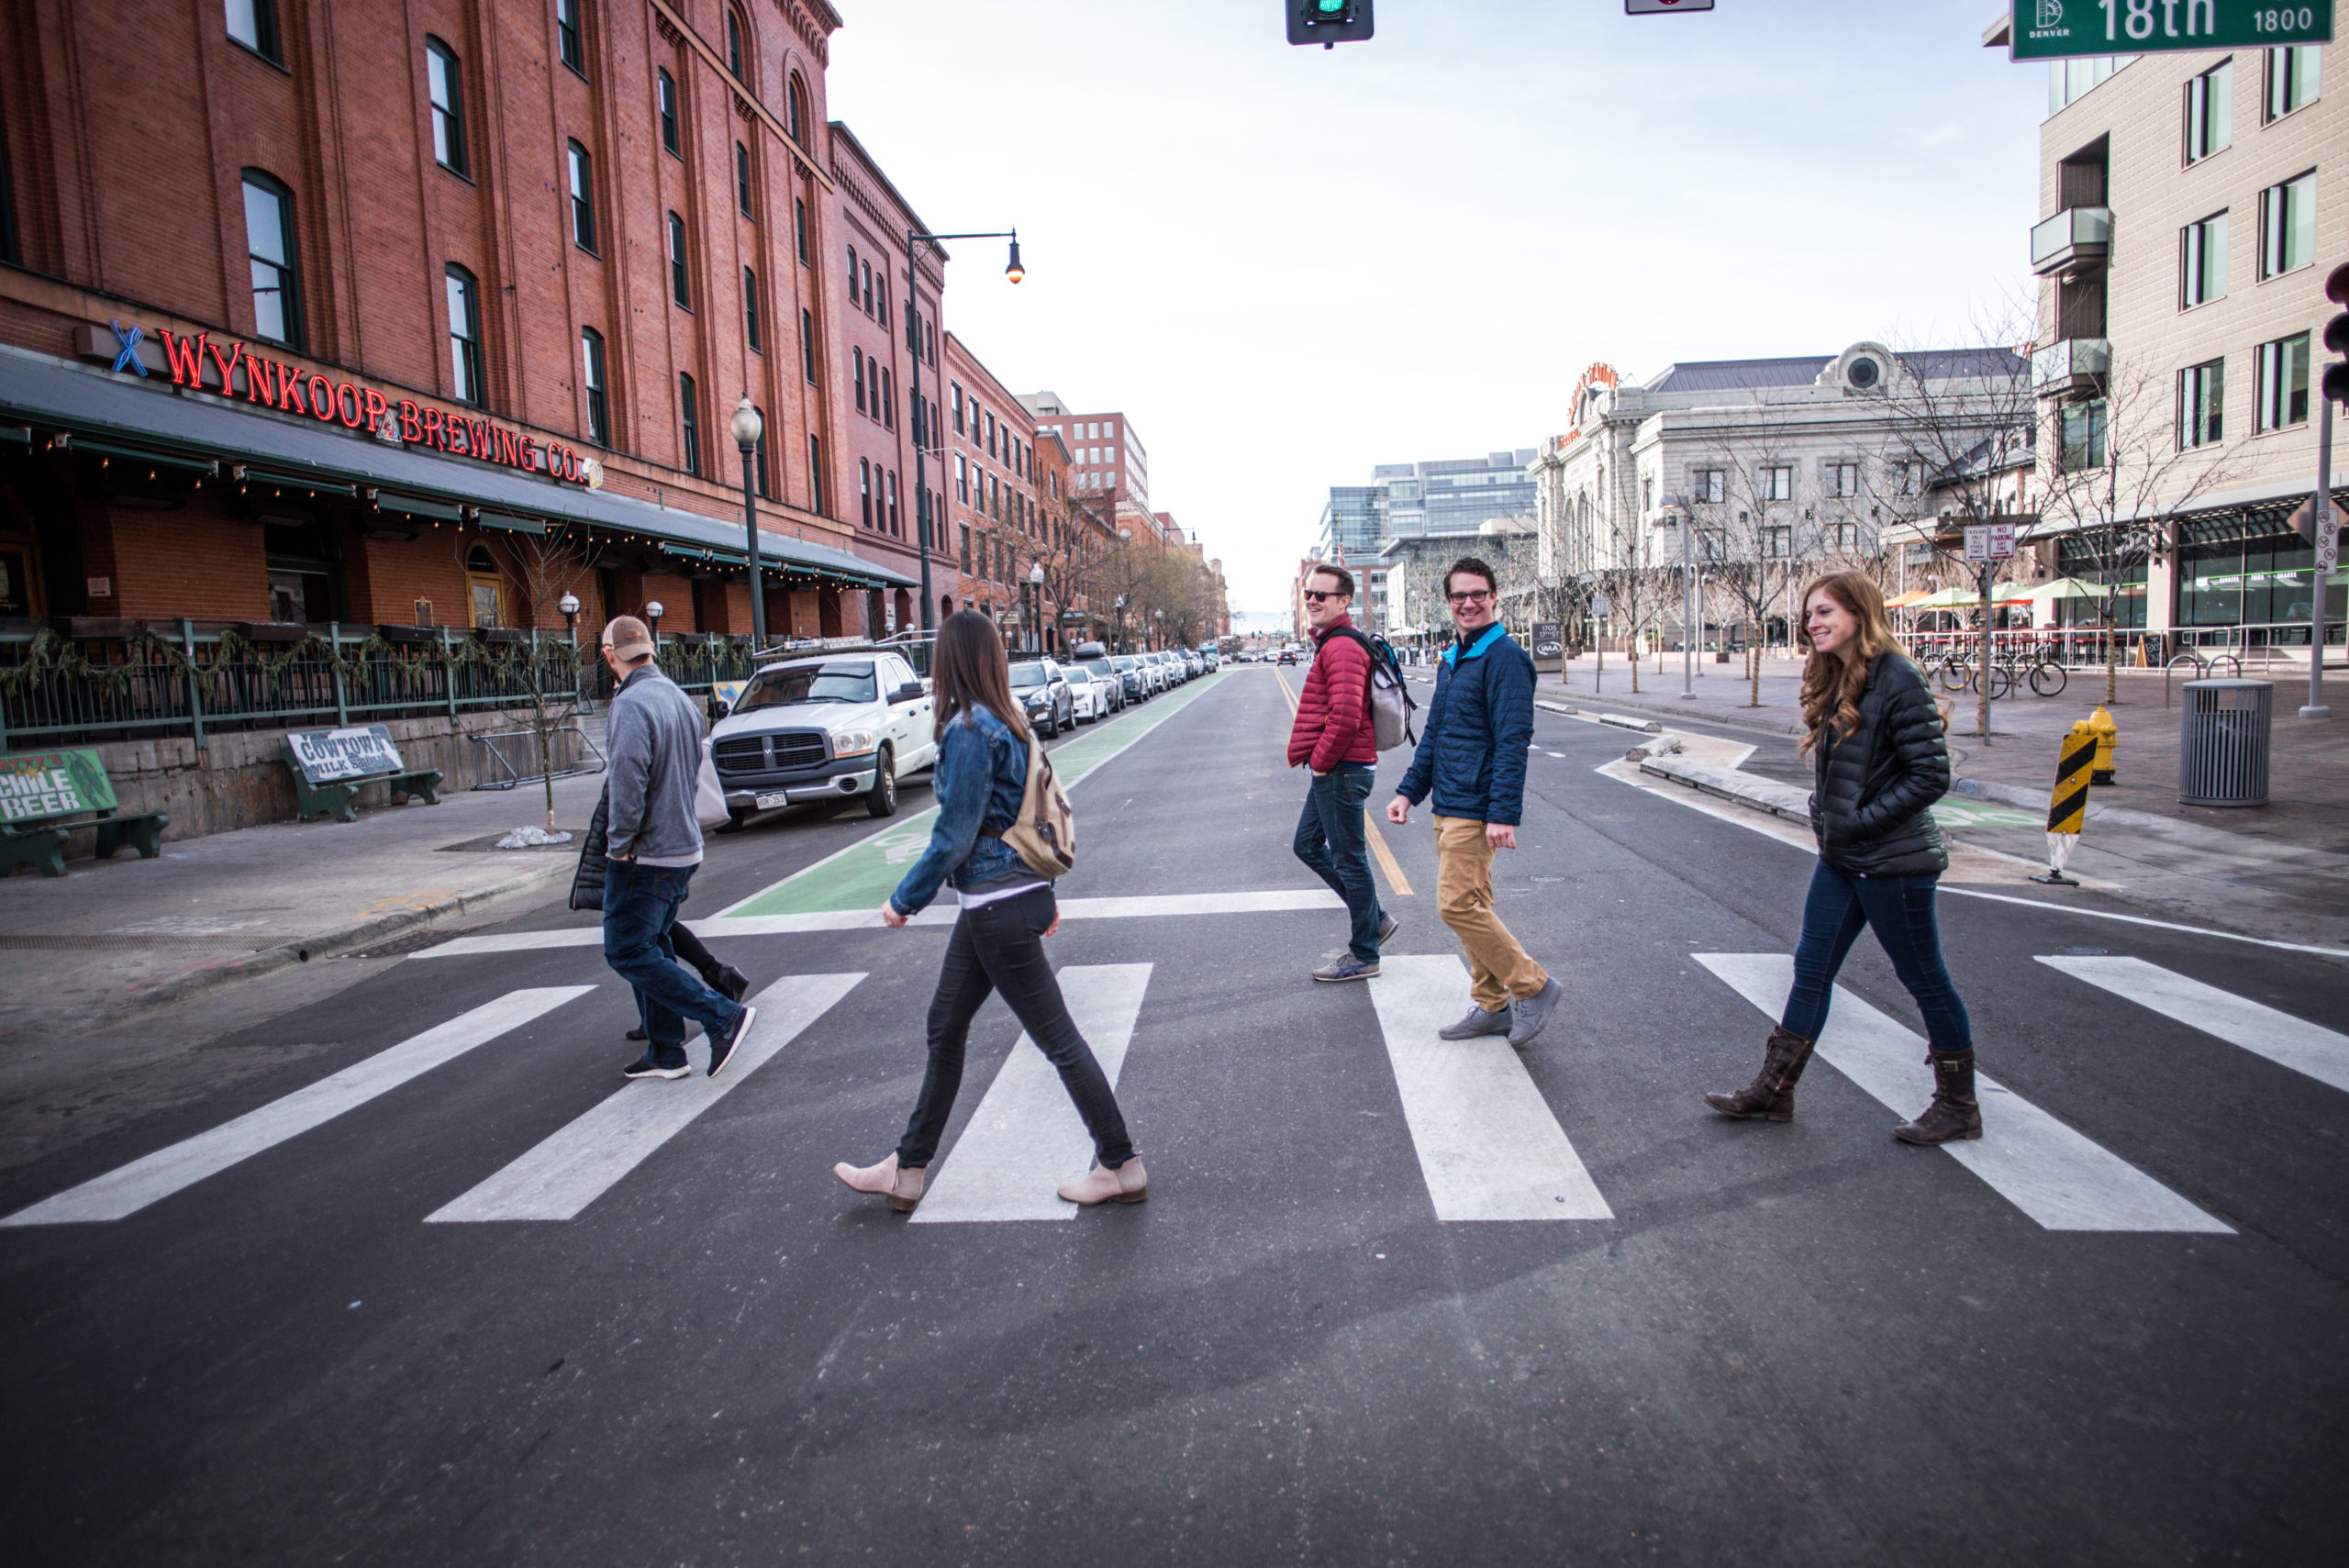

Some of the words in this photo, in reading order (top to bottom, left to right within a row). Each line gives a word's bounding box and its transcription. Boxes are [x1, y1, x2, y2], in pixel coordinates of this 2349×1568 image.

[2029, 28, 2070, 39] DENVER
[2099, 0, 2214, 40] 18th
[2254, 8, 2312, 32] 1800
[156, 328, 387, 433] WYNKOOP
[397, 399, 537, 473] BREWING
[545, 441, 584, 484] CO.
[300, 733, 386, 762] COWTOWN
[309, 760, 349, 776] MILK
[0, 768, 72, 798] CHILE
[1, 791, 81, 820] BEER
